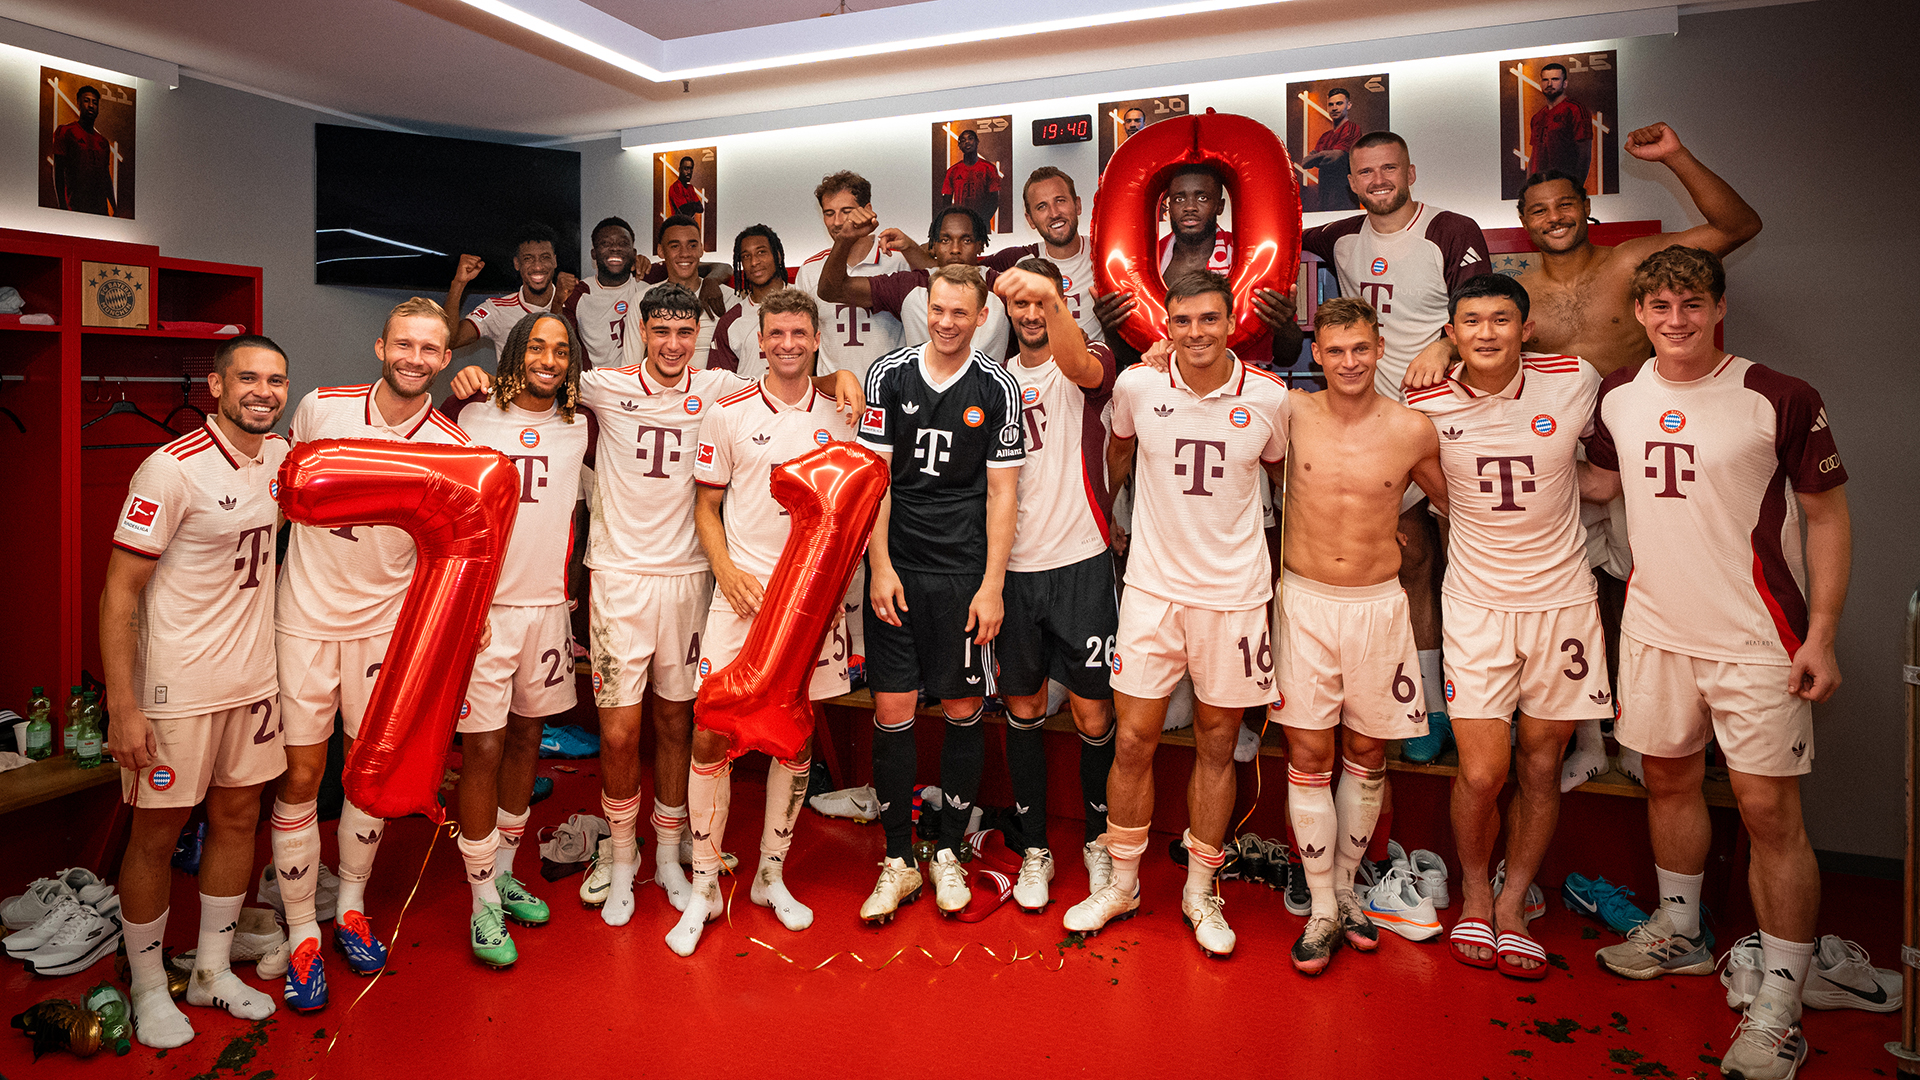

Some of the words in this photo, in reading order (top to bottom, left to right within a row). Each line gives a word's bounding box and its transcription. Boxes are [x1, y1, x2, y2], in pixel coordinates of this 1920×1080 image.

[1364, 77, 1385, 92] 6
[1568, 54, 1612, 73] 15
[976, 118, 1009, 134] 39
[1154, 97, 1186, 114] 10
[1042, 120, 1088, 139] 19:40
[702, 149, 715, 162] 2
[836, 305, 871, 347] T
[637, 425, 682, 479] T
[915, 428, 953, 477] T
[996, 448, 1023, 458] Allianz
[1175, 438, 1226, 496] T
[1645, 441, 1695, 499] T
[509, 455, 549, 503] T
[1477, 455, 1535, 511] T
[237, 524, 272, 590] T
[964, 637, 972, 668] 1
[1085, 635, 1116, 668] 26
[1238, 631, 1274, 678] 16
[1560, 637, 1590, 681] 3
[1391, 662, 1417, 704] 6
